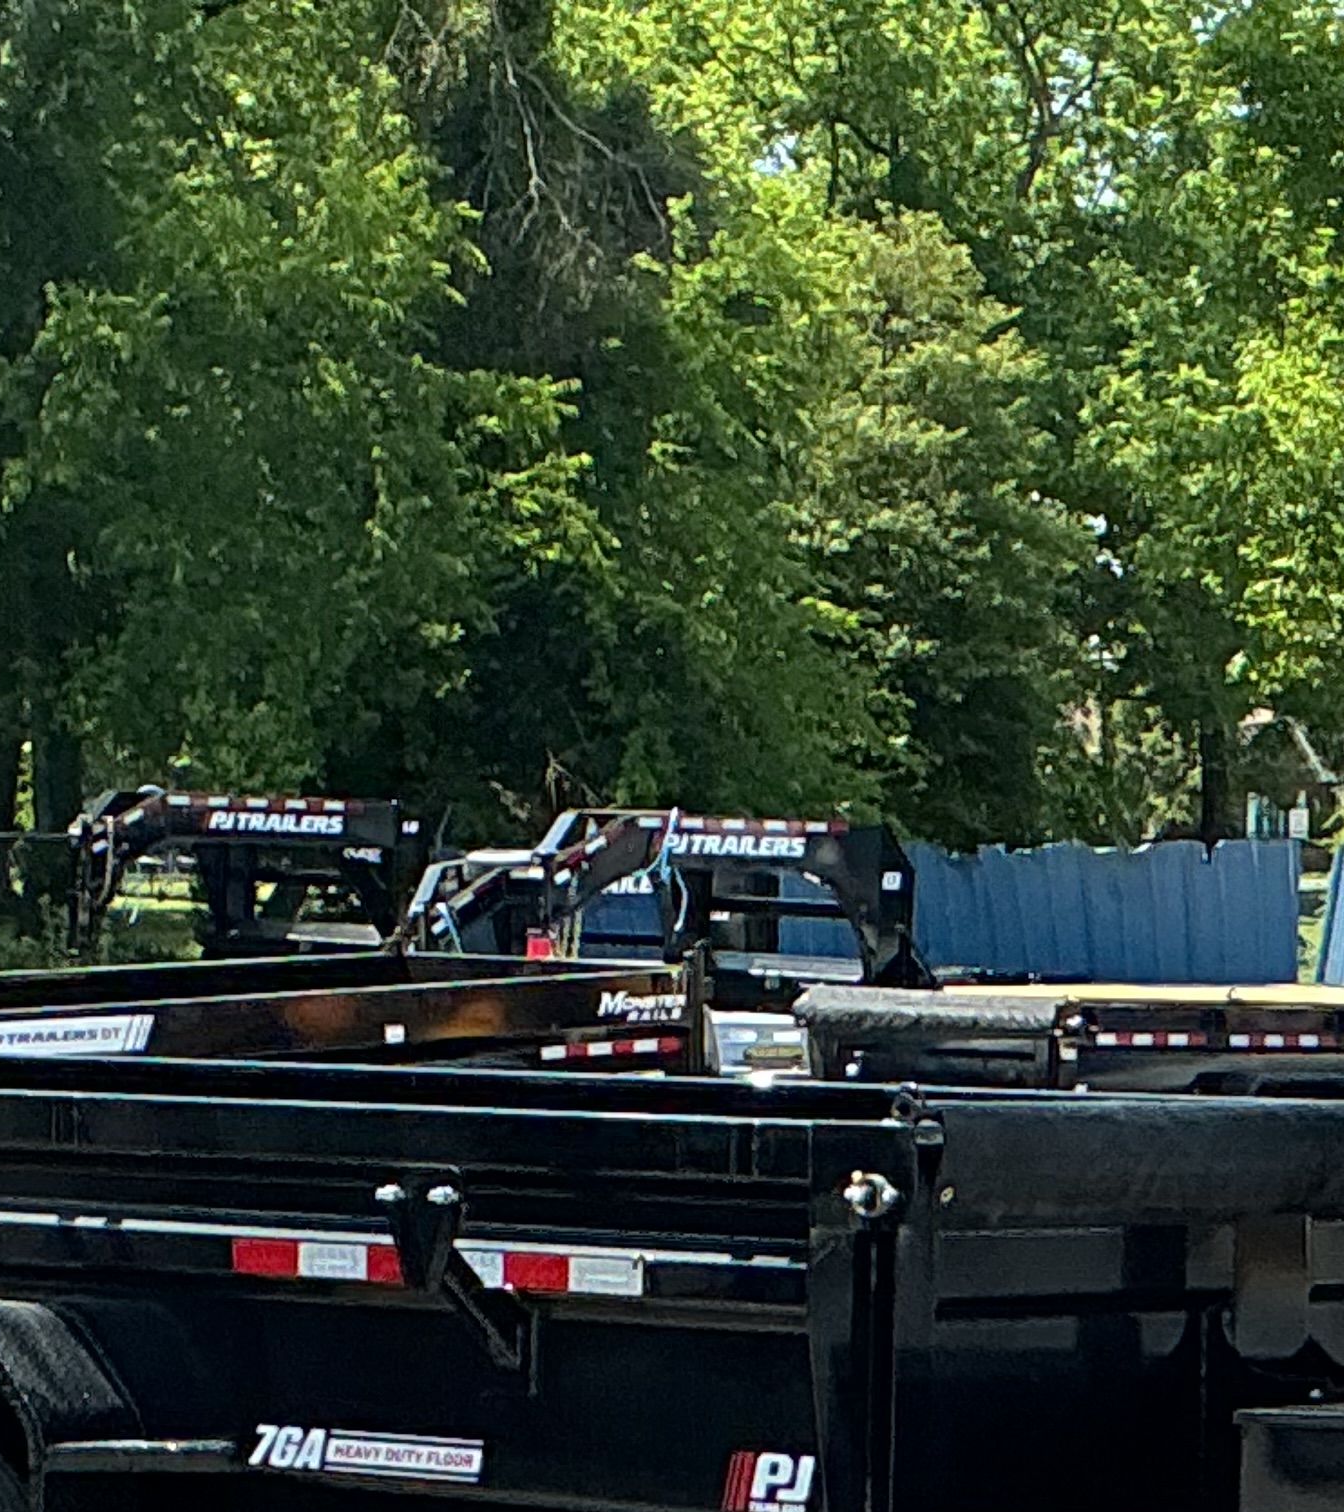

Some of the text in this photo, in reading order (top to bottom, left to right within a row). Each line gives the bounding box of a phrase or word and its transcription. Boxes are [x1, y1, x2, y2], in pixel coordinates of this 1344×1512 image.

[208, 811, 343, 834] PJ TRAILERS
[666, 832, 806, 857] PJ TRAILERS
[7, 1028, 98, 1045] TRAILERS
[100, 1026, 122, 1041] DT
[248, 1422, 474, 1470] 7GA HEAVY DUTY FLOOR
[749, 1452, 816, 1502] PJ
